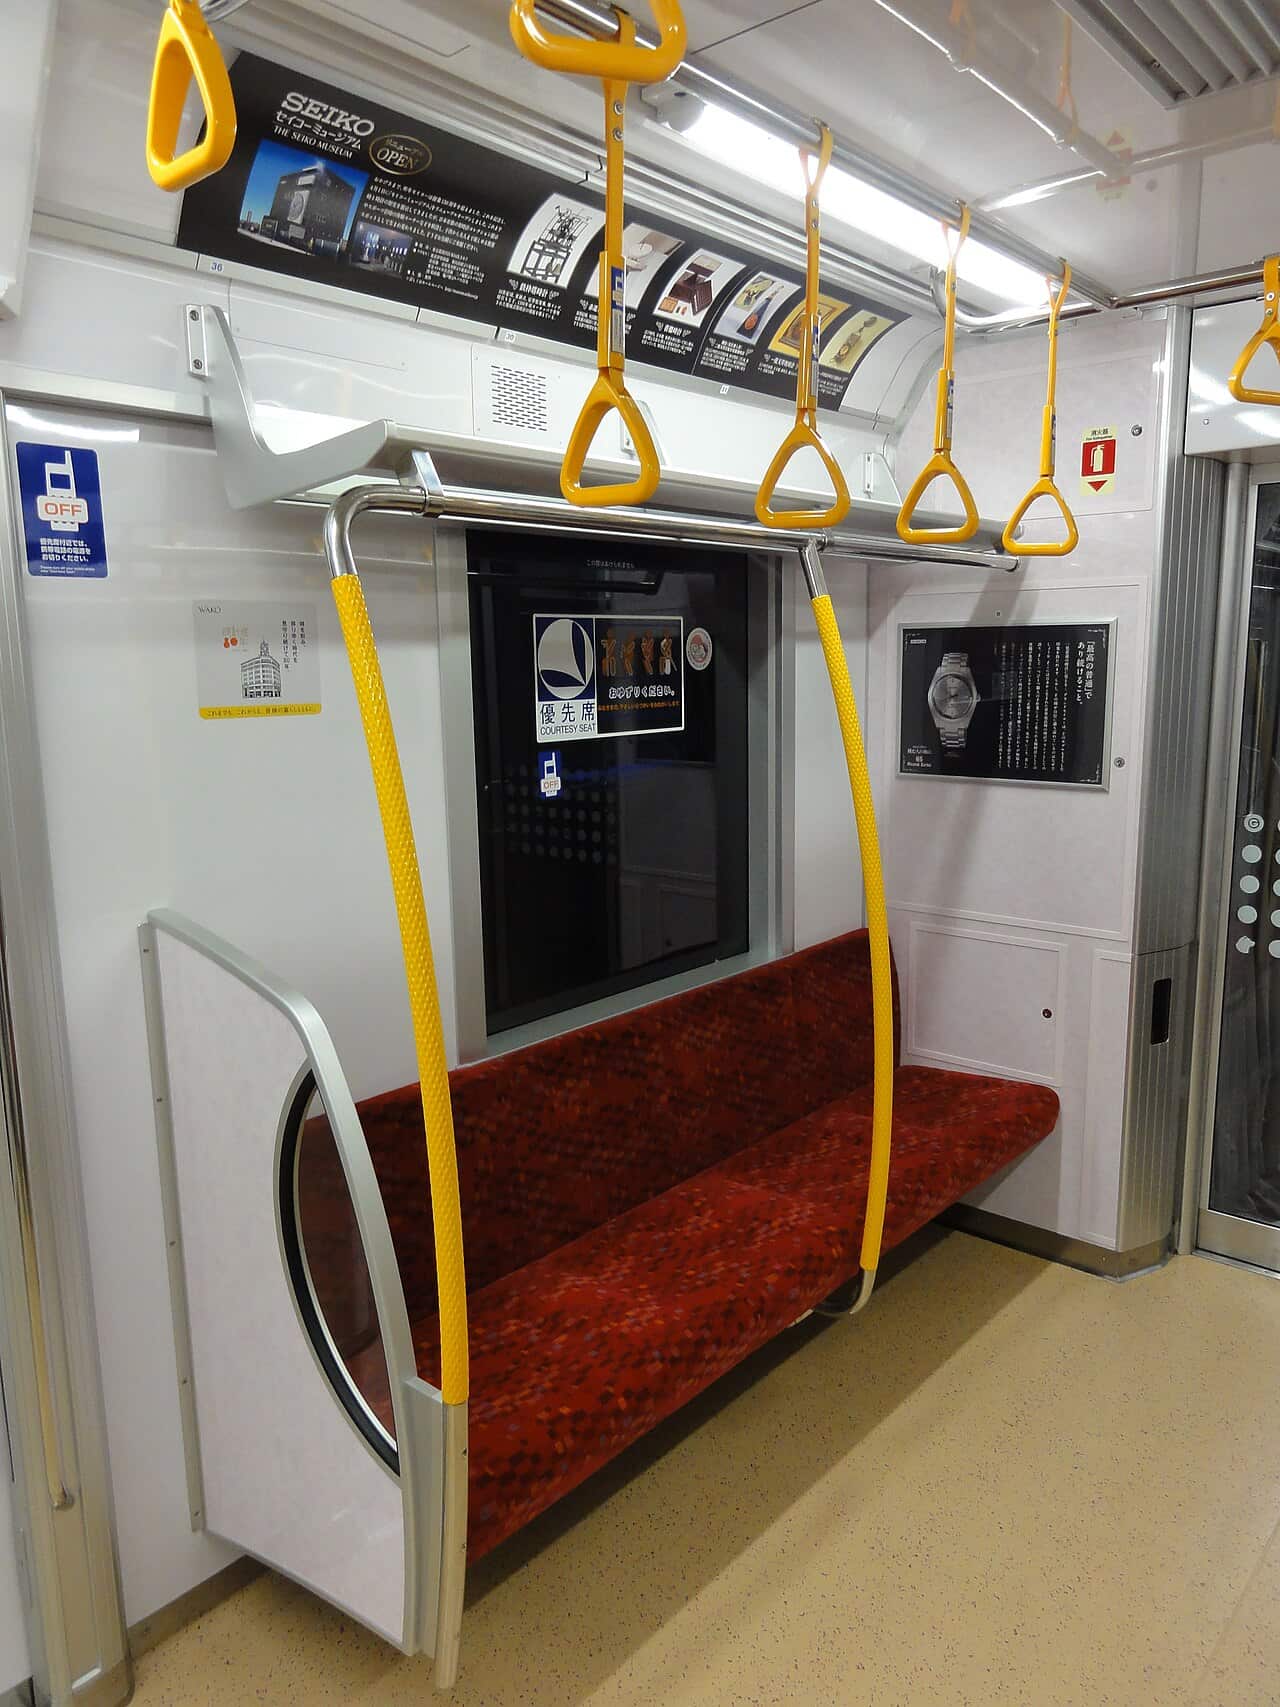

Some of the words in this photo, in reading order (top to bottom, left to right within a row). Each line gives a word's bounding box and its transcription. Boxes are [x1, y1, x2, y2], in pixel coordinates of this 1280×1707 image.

[280, 92, 375, 137] SEIKO
[275, 110, 362, 151] セイコーミュージアム
[273, 126, 290, 138] THE
[290, 131, 317, 147] SEIKO
[317, 138, 353, 159] MUSEUM
[376, 147, 418, 169] OPEN
[44, 502, 82, 517] OFF
[608, 684, 676, 700] おゆずりください。
[540, 702, 596, 725] 優先席
[540, 725, 578, 736] COURTESY
[578, 723, 596, 733] SEAT
[543, 779, 559, 789] OFF
